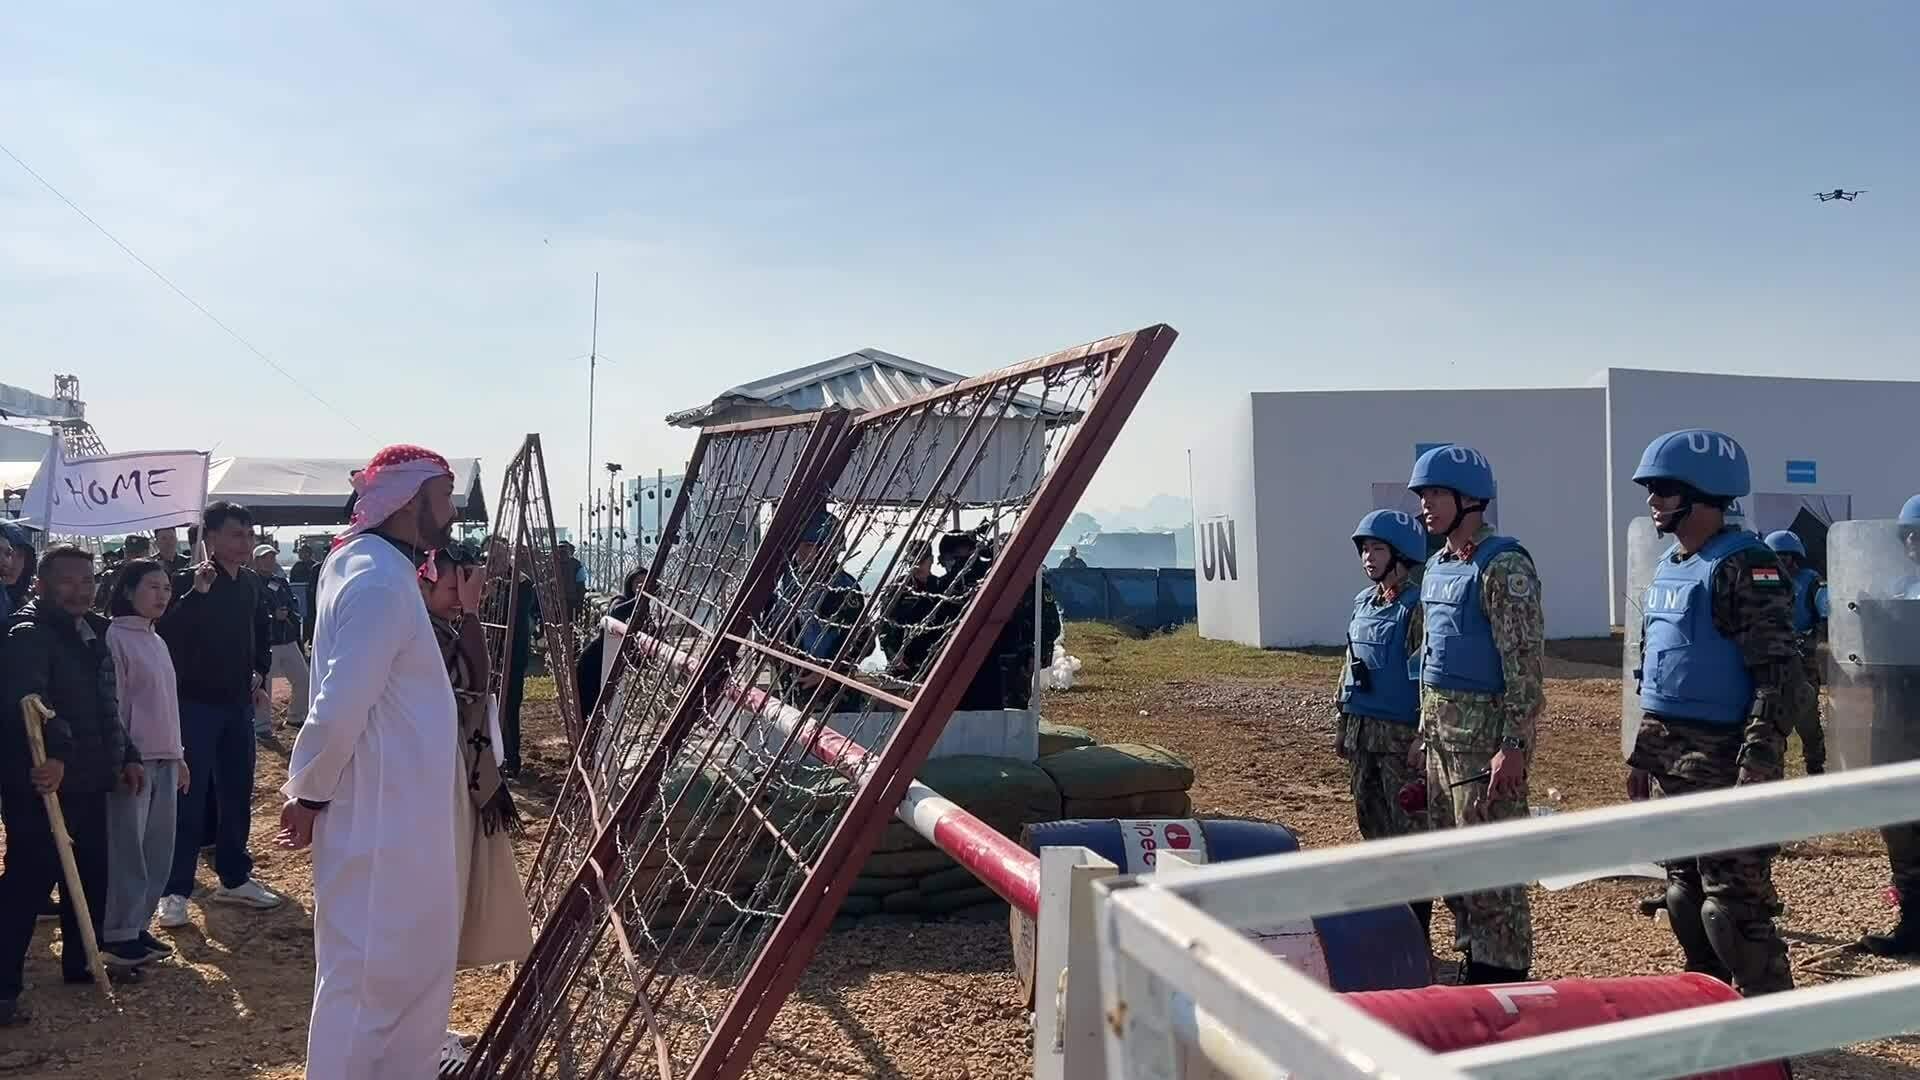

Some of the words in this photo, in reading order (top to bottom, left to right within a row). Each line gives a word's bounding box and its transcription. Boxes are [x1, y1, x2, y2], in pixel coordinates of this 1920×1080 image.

[1447, 447, 1487, 469] UN
[1688, 432, 1737, 460] UN
[64, 468, 176, 511] HOME
[1200, 519, 1238, 582] UN
[1426, 579, 1460, 600] UN
[1648, 589, 1679, 610] UN
[1133, 821, 1158, 867] ipec
